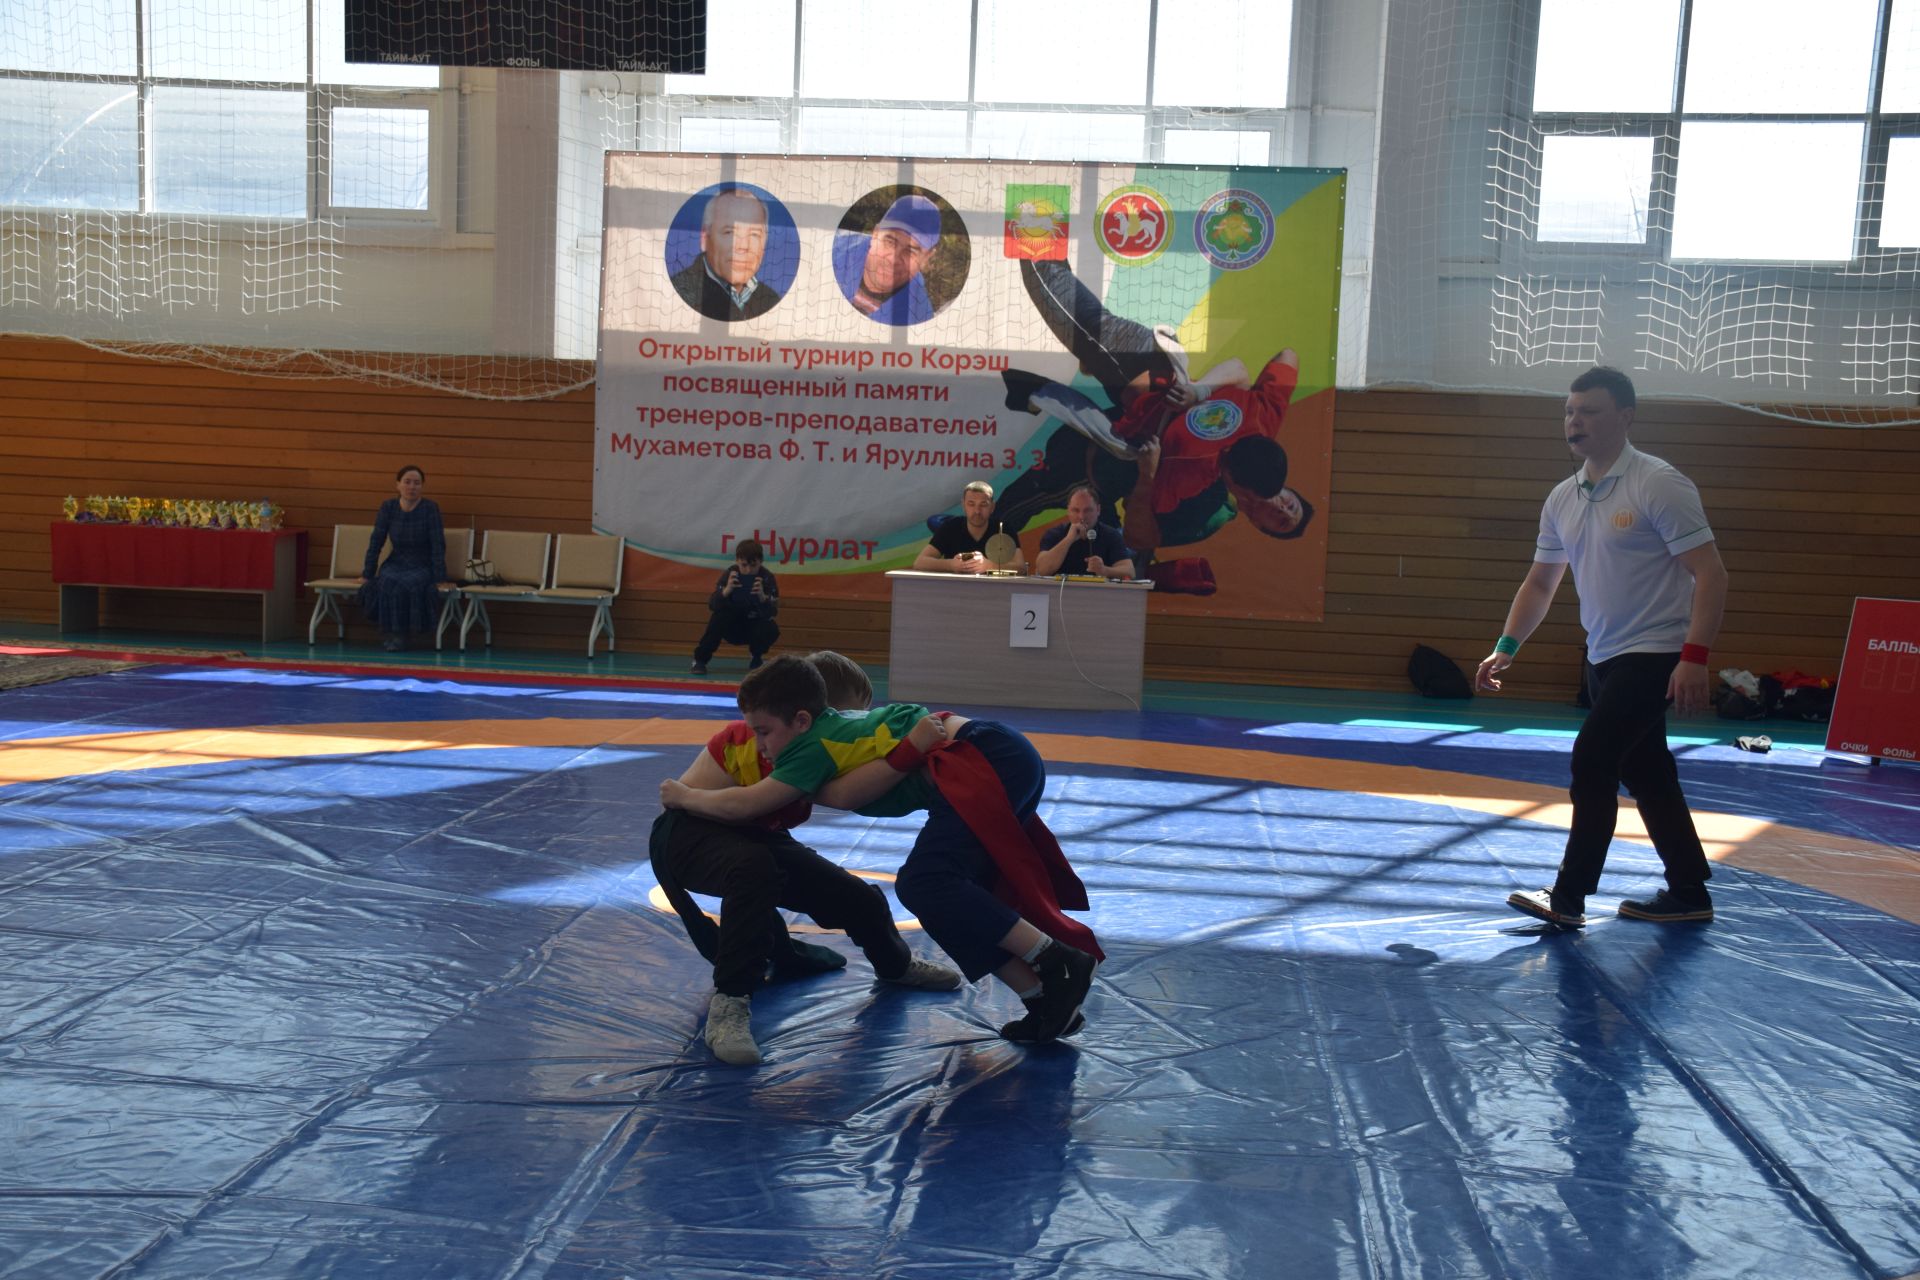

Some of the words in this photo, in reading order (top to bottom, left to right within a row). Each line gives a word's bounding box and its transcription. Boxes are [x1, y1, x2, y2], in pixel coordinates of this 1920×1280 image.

[380, 52, 431, 64] ТАЙМ-АУТ
[638, 337, 773, 366] Открытый
[780, 347, 873, 371] турнир
[881, 350, 914, 370] по
[921, 347, 1010, 374] Корэш
[664, 375, 847, 398] посвященный
[854, 384, 950, 402] памяти
[637, 408, 997, 435] тренеров-преподавателей
[610, 433, 772, 461] Мухаметова
[779, 439, 806, 461] Ф.
[812, 441, 835, 462] Т.
[842, 447, 857, 463] и
[866, 444, 995, 470] Яруллина
[1002, 448, 1022, 470] З.
[754, 529, 878, 565] Нурлат
[1024, 610, 1037, 630] 2
[1841, 742, 1868, 752] ОЧКИ
[1882, 747, 1916, 759] ФОЛЫ
